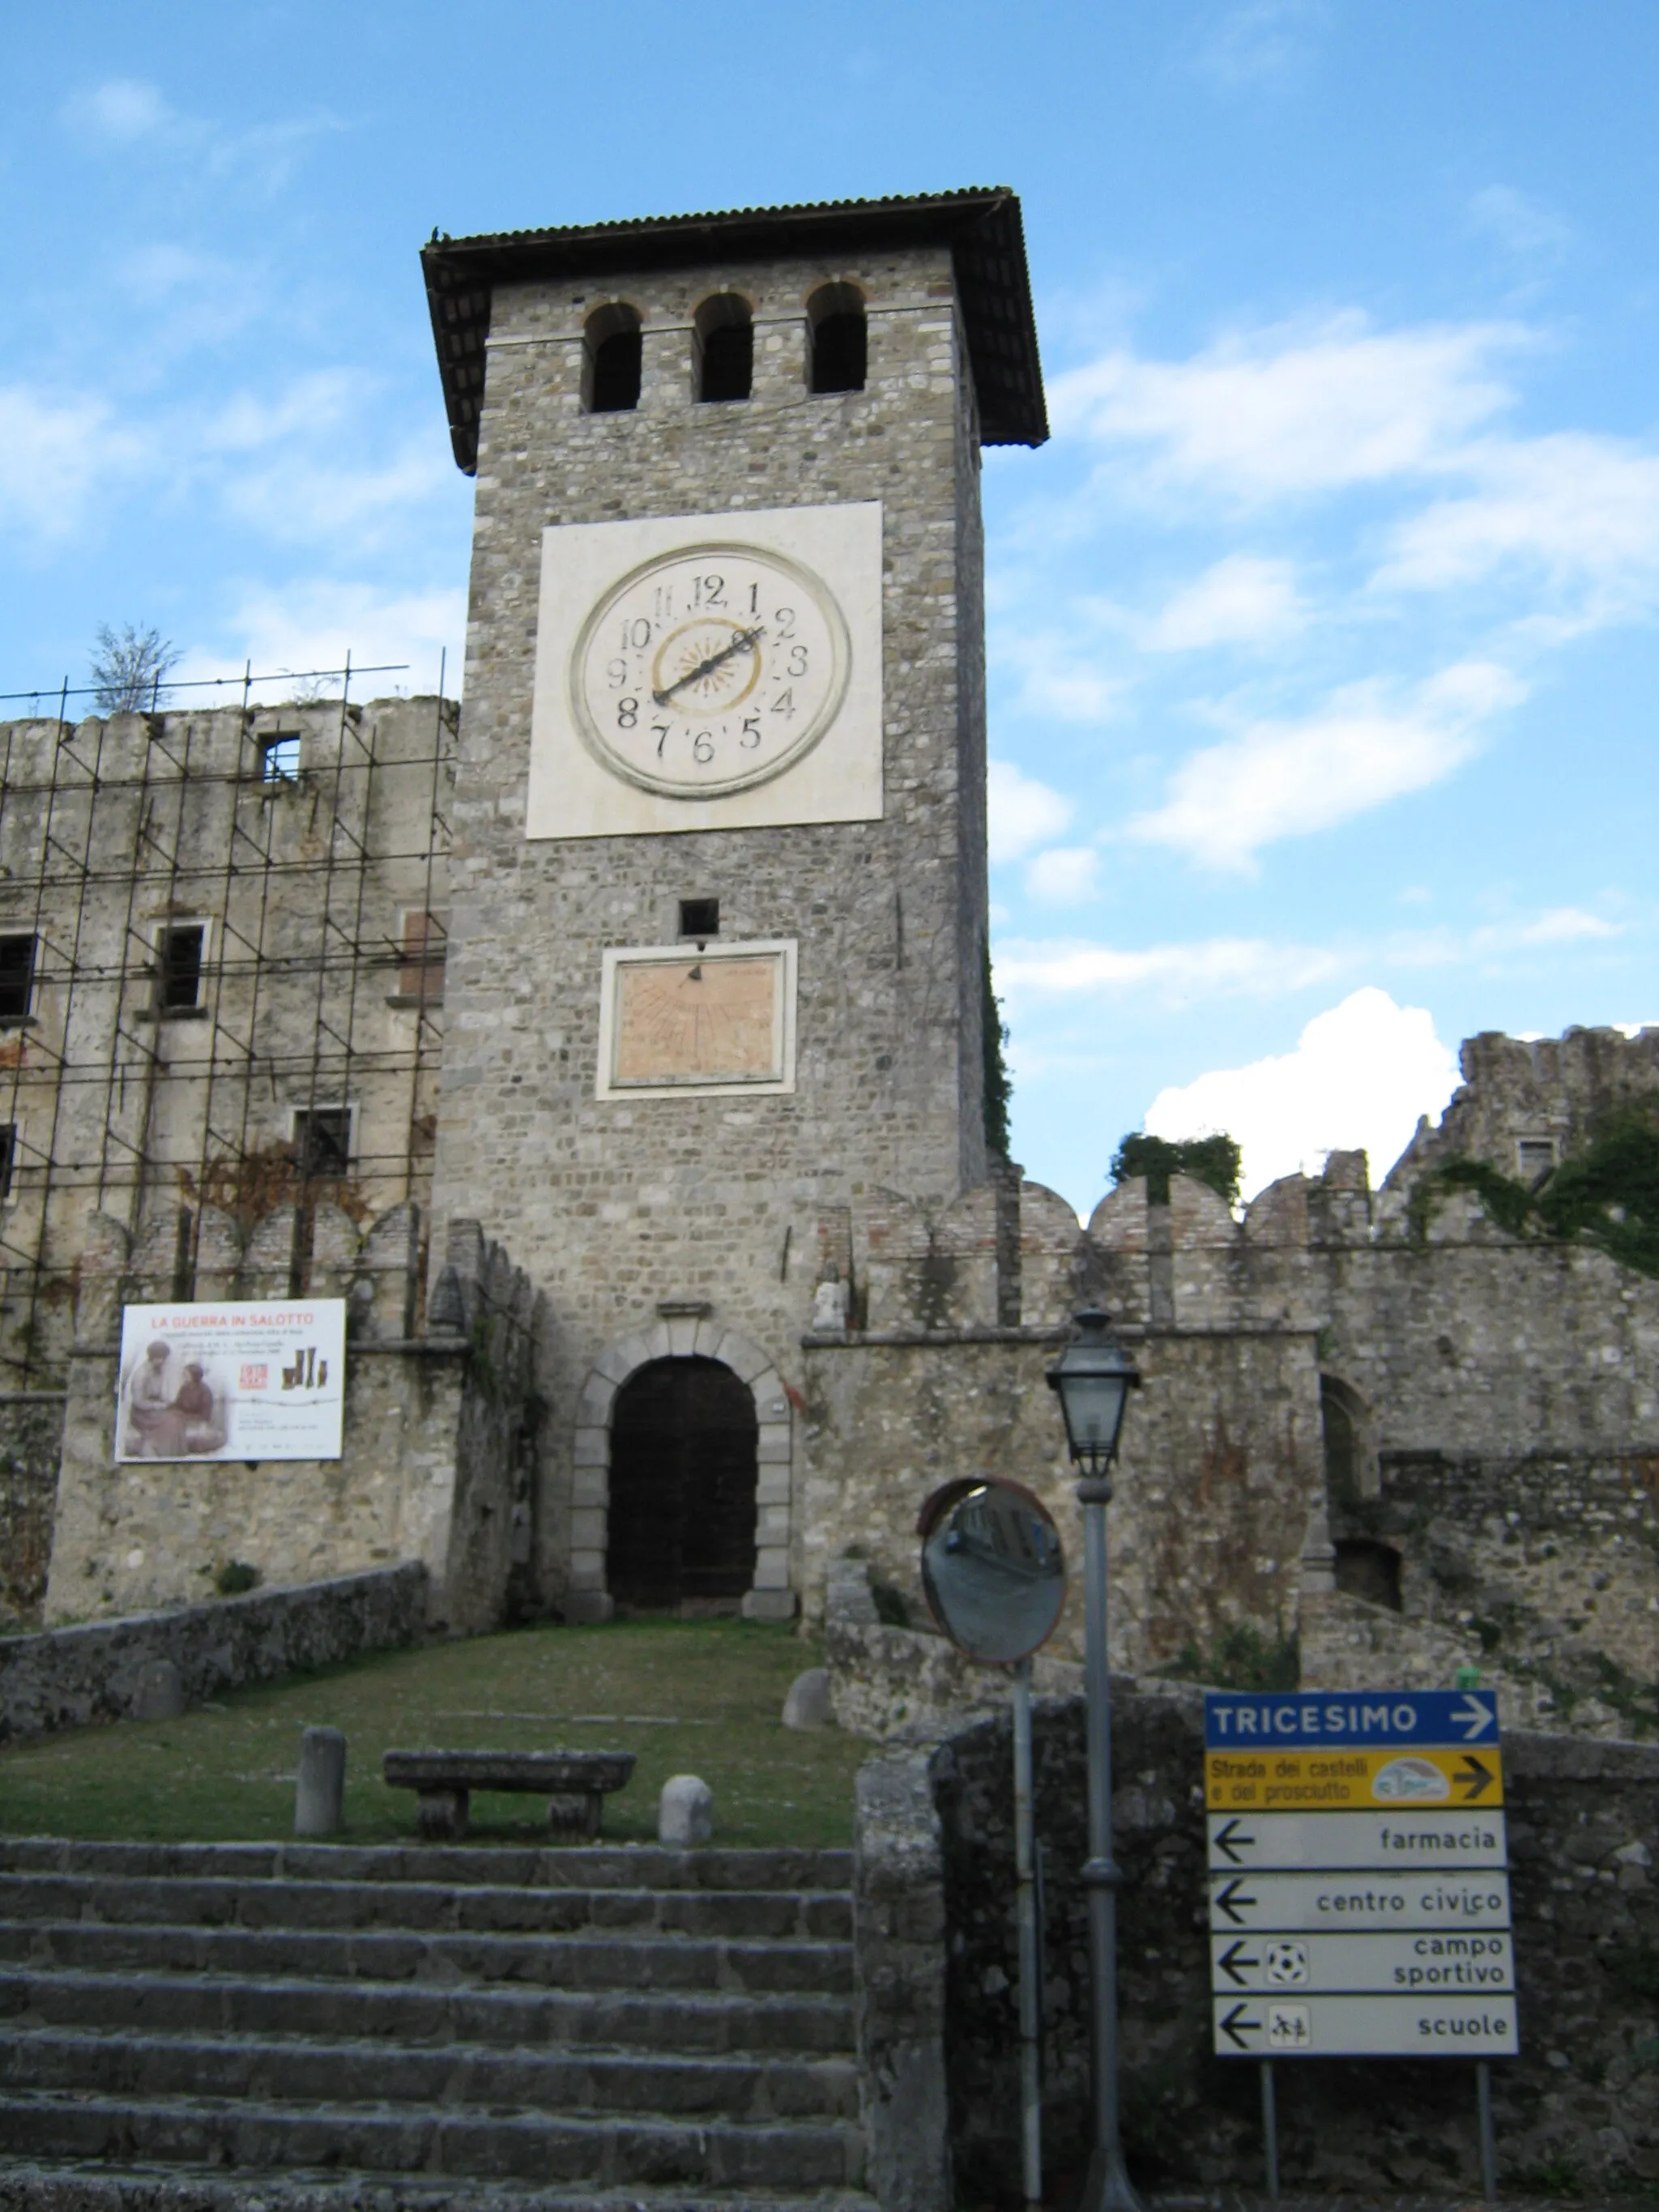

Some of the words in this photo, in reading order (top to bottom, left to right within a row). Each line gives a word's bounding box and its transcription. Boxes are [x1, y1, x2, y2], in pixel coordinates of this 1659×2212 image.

[655, 586, 674, 617] 11
[693, 574, 726, 606] 12
[748, 582, 759, 613] 1
[621, 619, 651, 650] 10
[774, 607, 796, 639] 2
[608, 658, 628, 689] 9
[787, 646, 808, 677] 3
[617, 697, 638, 728] 8
[771, 687, 796, 719] 4
[650, 724, 670, 759] 7
[693, 731, 715, 764] 6
[740, 718, 761, 749] 5
[151, 1317, 167, 1329] LA
[172, 1315, 228, 1328] GUERRA
[230, 1315, 245, 1327] IN
[249, 1312, 313, 1326] SALOTTO
[1214, 1706, 1417, 1733] TRICESIMO
[1211, 1759, 1266, 1779] Strada
[1309, 1758, 1368, 1778] castelli
[1265, 1783, 1350, 1804] prosciutto
[1381, 1828, 1496, 1849] farmacia
[1316, 1891, 1405, 1912] centro
[1421, 1889, 1502, 1912] civico
[1414, 1938, 1503, 1958] campo
[1393, 1963, 1504, 1987] sportivo
[1418, 2015, 1508, 2035] scuole
